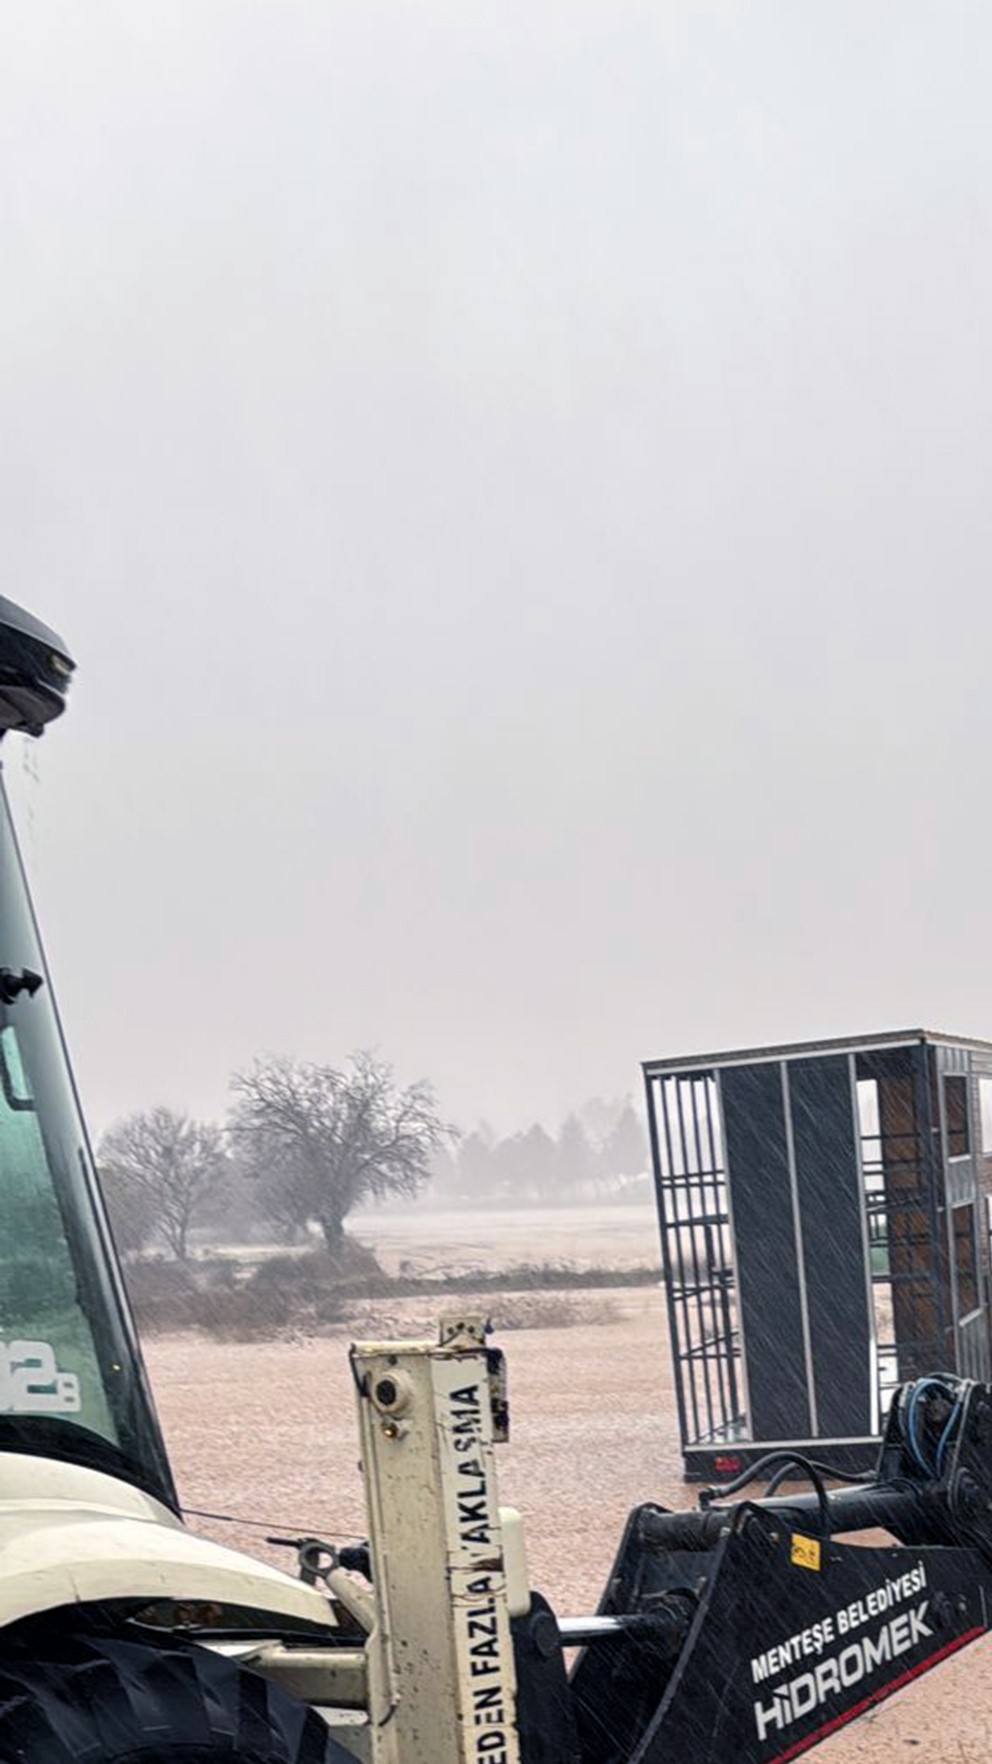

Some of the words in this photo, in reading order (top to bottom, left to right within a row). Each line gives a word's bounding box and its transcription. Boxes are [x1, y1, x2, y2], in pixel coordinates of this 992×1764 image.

[467, 1576, 501, 1677] FAZLA
[751, 1617, 835, 1684] MENTEŞE
[836, 1560, 927, 1635] BELEDİYESİ
[754, 1600, 935, 1741] HİDROMEK
